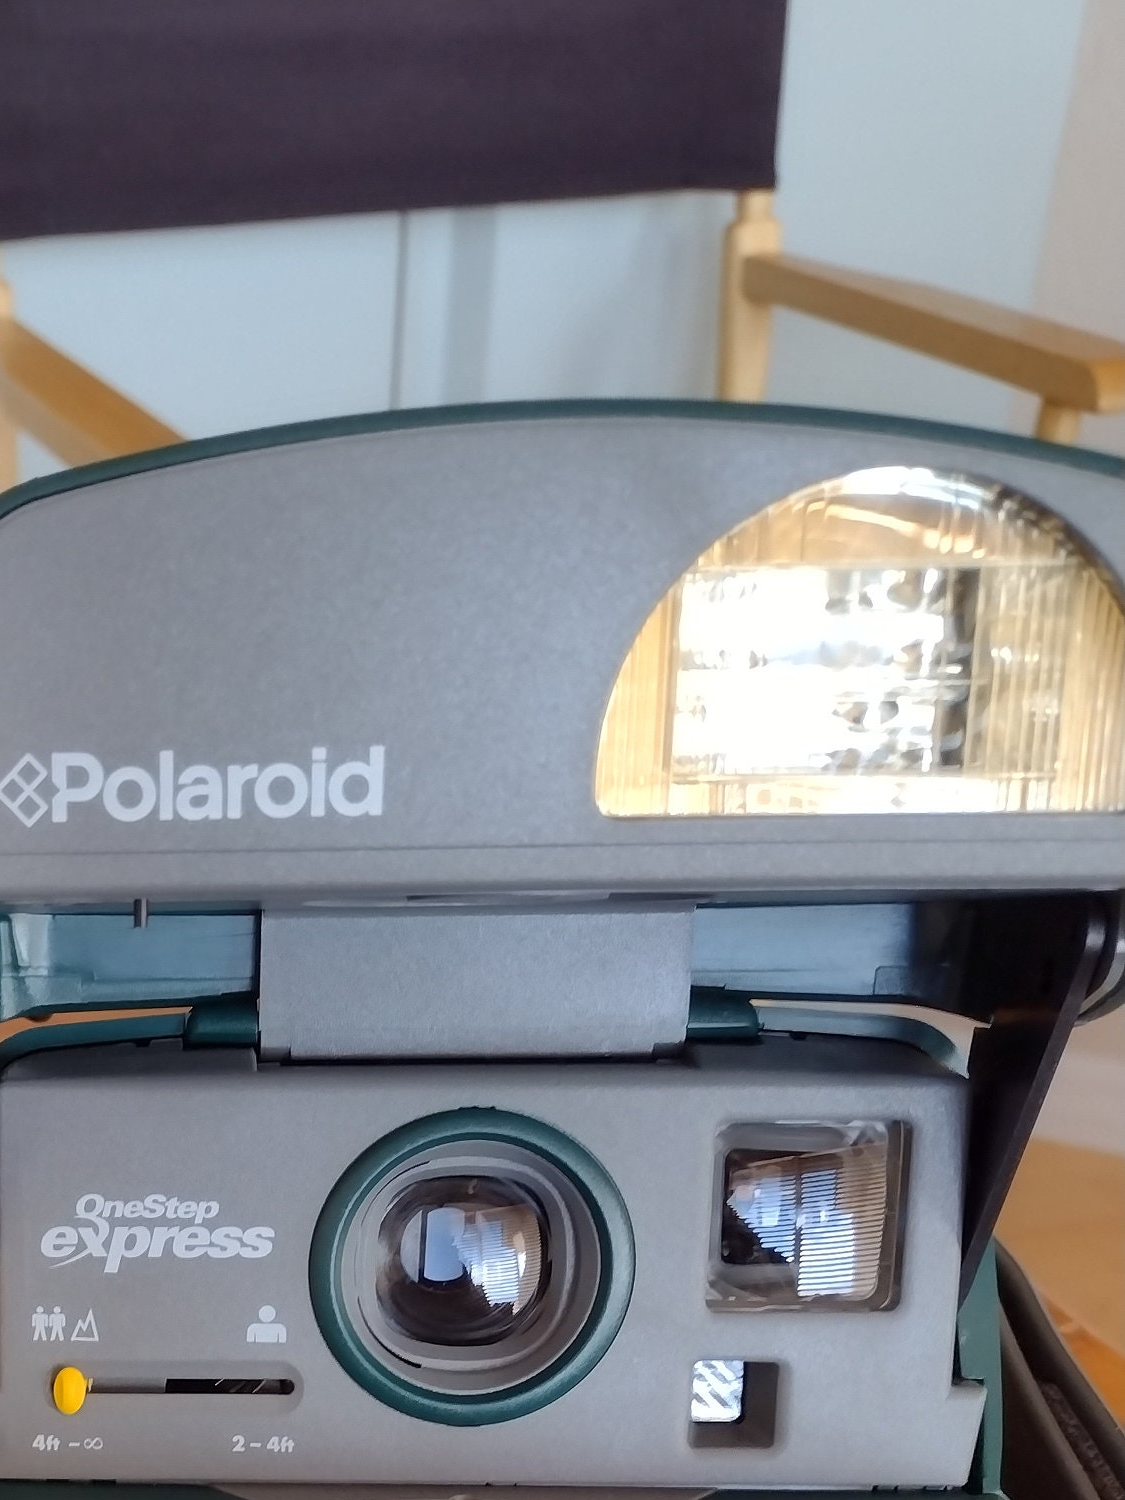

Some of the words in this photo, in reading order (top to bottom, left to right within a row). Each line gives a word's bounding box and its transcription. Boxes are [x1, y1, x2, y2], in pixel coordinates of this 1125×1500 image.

[51, 745, 386, 823] Polaroid
[74, 1193, 220, 1224] OneStep
[40, 1225, 276, 1273] express
